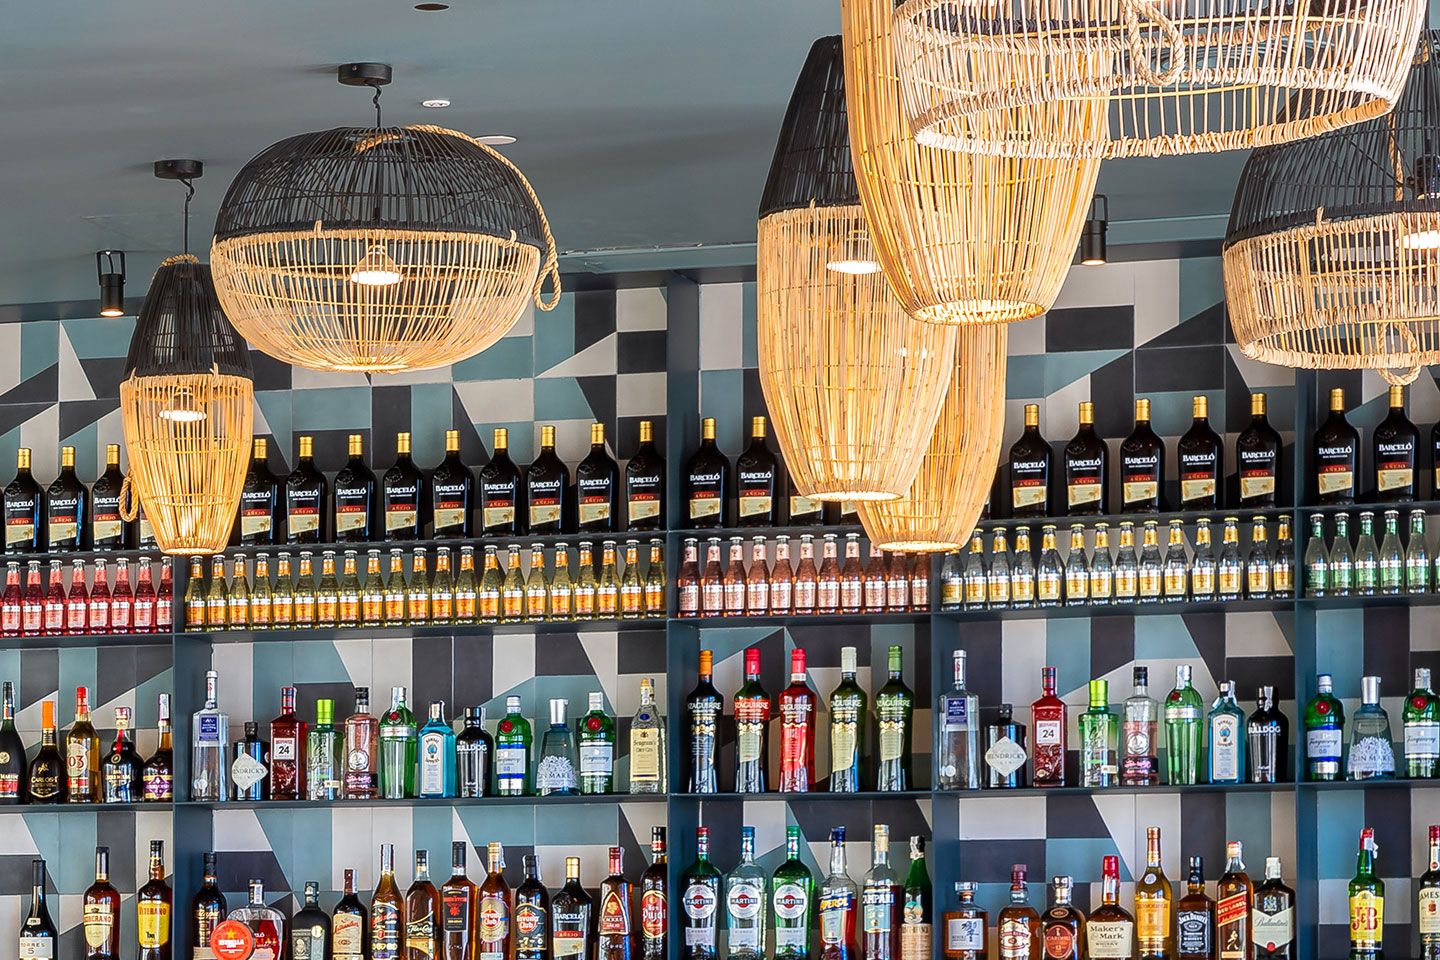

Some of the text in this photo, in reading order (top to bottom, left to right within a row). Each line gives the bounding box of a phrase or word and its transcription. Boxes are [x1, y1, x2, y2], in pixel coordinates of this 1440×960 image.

[1042, 729, 1054, 738] 24
[278, 746, 290, 754] 24
[554, 912, 584, 920] BARCELÓ
[1351, 906, 1379, 931] J&B
[1090, 925, 1124, 933] Maker's
